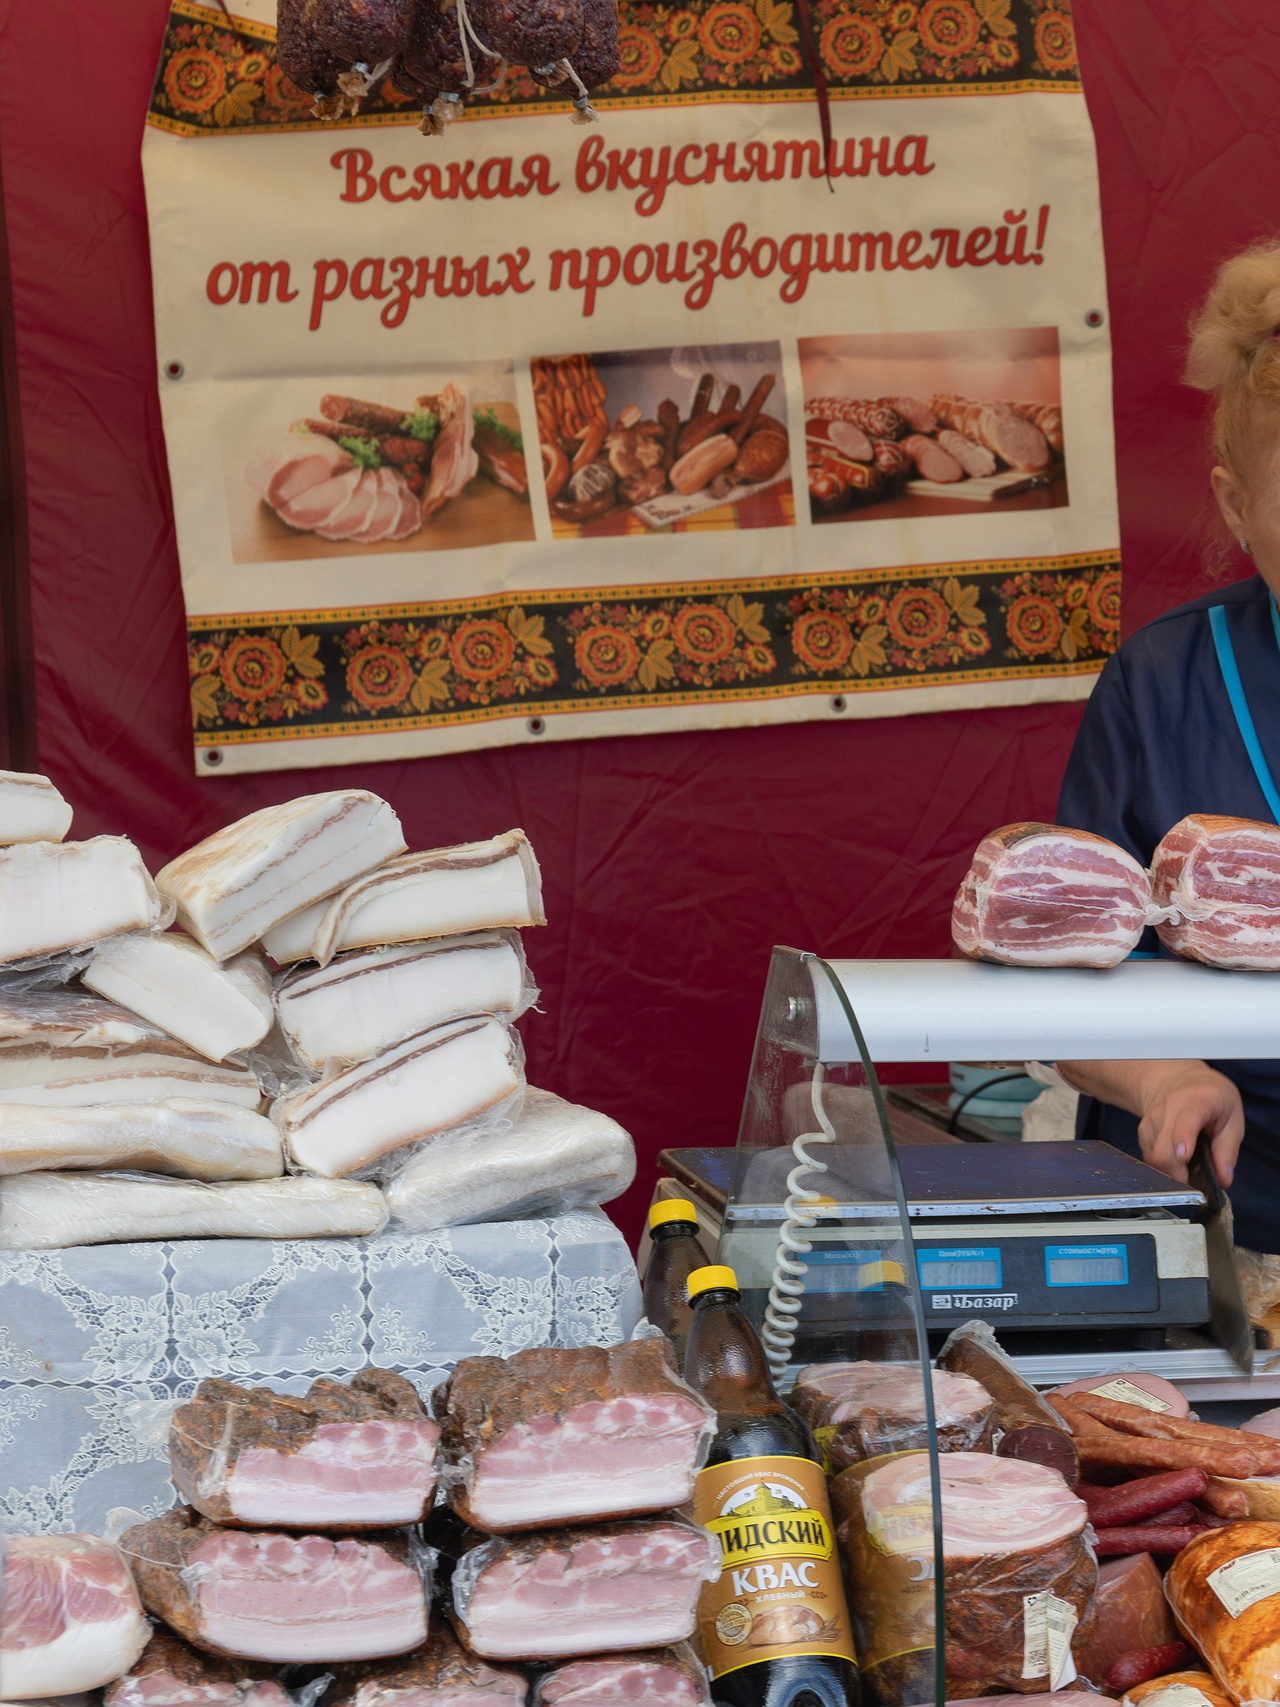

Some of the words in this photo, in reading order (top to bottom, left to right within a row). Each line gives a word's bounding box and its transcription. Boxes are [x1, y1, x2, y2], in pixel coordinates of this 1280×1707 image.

[330, 148, 559, 203] Всякая
[576, 135, 934, 217] вкуснятина
[206, 260, 298, 306] от
[310, 247, 534, 331] разных
[550, 205, 1052, 317] производителей!
[716, 1472, 754, 1500] НАСТОЯЩИЙ
[730, 1561, 820, 1597] КВАС
[755, 1589, 806, 1603] ХЛЕБНЫЙ
